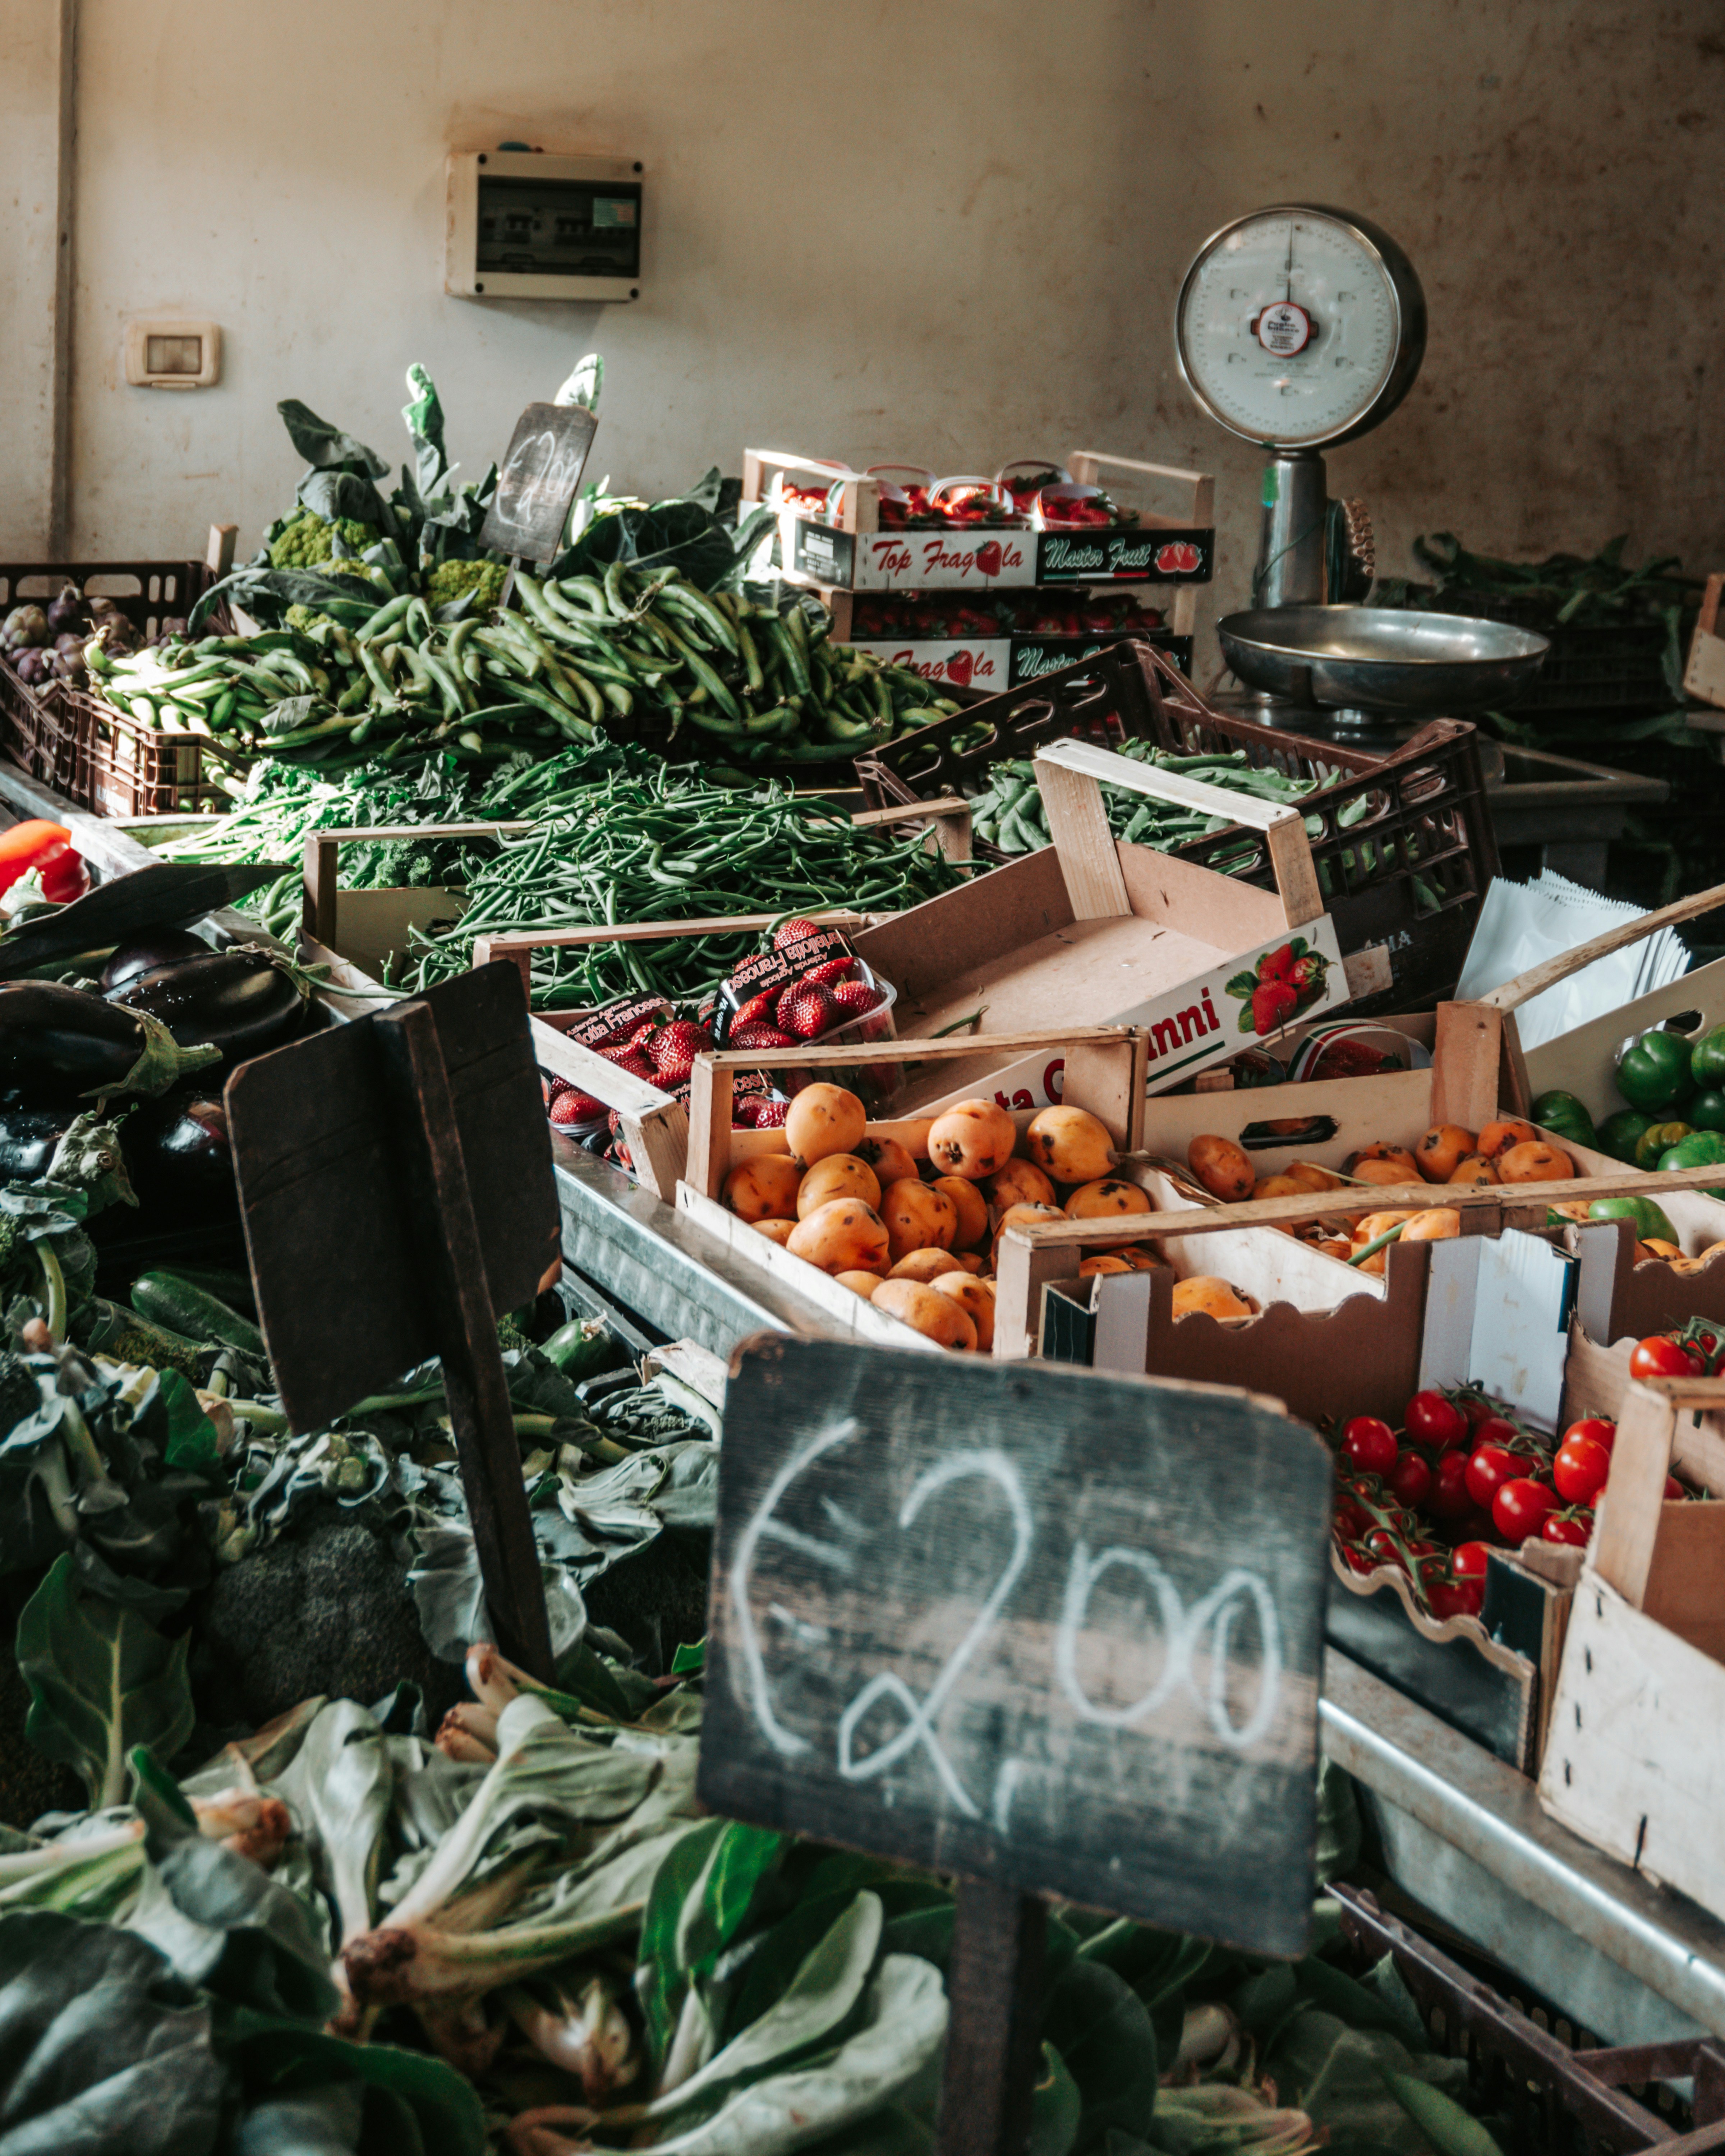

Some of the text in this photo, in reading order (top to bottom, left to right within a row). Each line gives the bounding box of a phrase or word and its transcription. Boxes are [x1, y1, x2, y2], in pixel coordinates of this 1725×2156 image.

[873, 540, 913, 577] Top
[1045, 538, 1151, 571] Master Fruit
